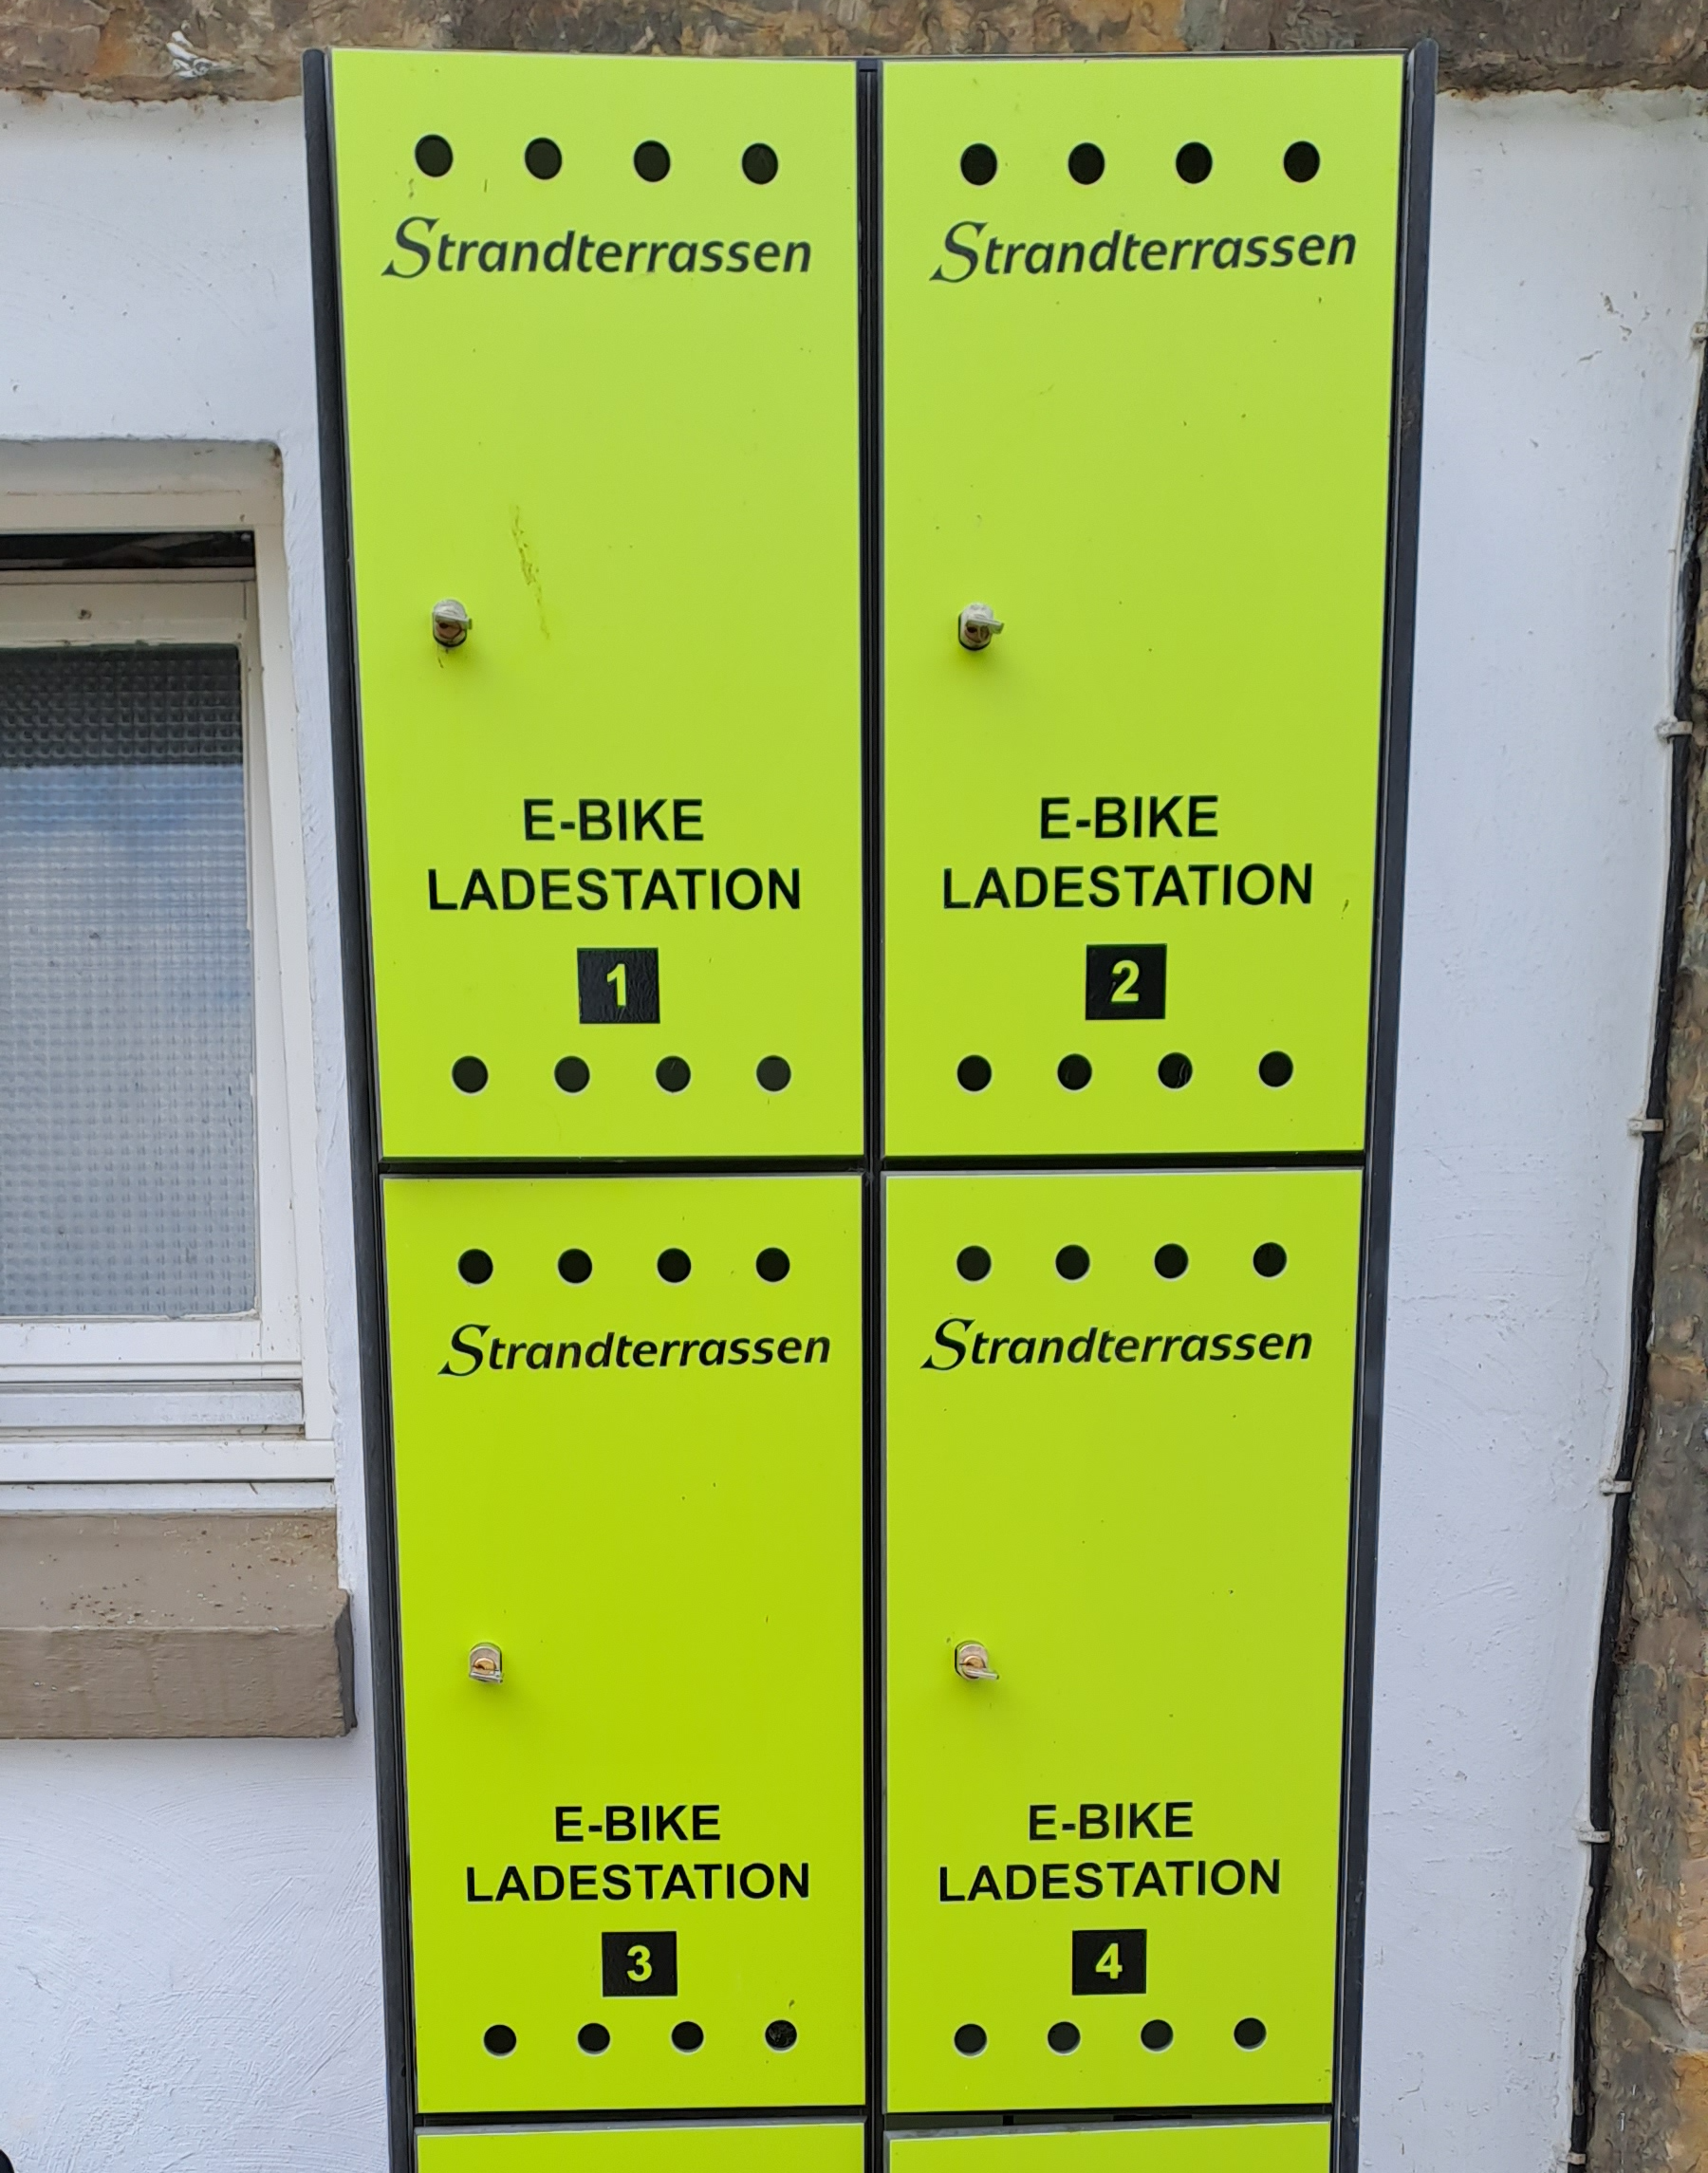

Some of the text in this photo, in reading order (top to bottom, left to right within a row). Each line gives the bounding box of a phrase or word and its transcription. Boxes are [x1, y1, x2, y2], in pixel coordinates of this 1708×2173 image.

[381, 217, 811, 279] Strandterrassen
[930, 221, 1356, 283] Strandterrassen
[523, 798, 704, 842] E-BIKE
[1040, 794, 1218, 839] E-BIKE
[428, 867, 800, 911] LADESTATION
[943, 863, 1312, 909] LADESTATION
[606, 963, 627, 1007] 1
[1110, 959, 1140, 1003] 2
[437, 1324, 830, 1377] Strandterrassen
[919, 1318, 1312, 1371] Strandterrassen
[555, 1804, 721, 1843] E-BIKE
[1029, 1801, 1194, 1841] E-BIKE
[466, 1862, 809, 1903] LADESTATION
[939, 1858, 1280, 1903] LADESTATION
[626, 1944, 653, 1982] 3
[1095, 1942, 1123, 1979] 4
